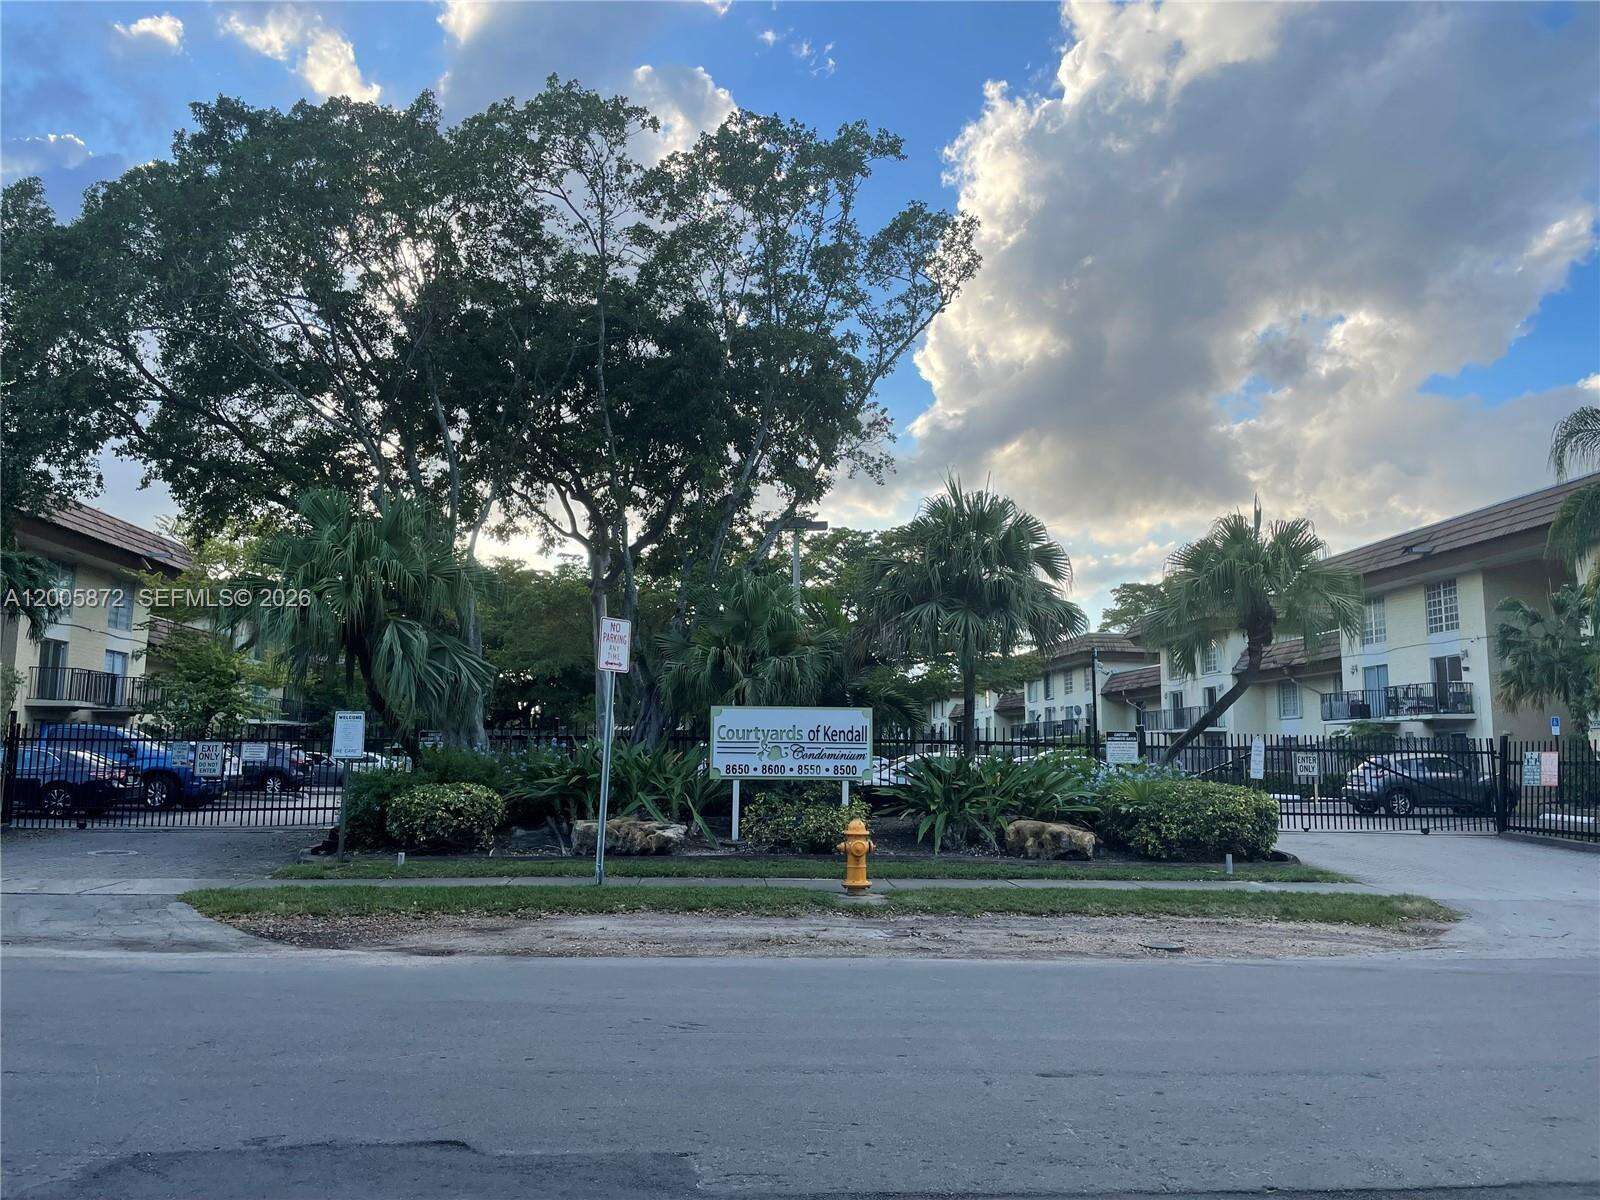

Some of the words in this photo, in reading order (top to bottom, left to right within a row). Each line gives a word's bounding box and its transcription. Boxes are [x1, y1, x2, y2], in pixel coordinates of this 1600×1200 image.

[610, 621, 621, 633] NO
[602, 632, 627, 645] PARKING
[717, 724, 804, 747] Courtyards
[807, 725, 820, 742] of
[823, 725, 868, 743] Kendall
[201, 744, 220, 752] EXIT
[790, 744, 867, 760] Condominium
[198, 752, 221, 760] ONLY
[1297, 755, 1317, 764] ENTER
[725, 764, 750, 775] 8650
[761, 764, 786, 775] 8600
[797, 764, 822, 775] 8550
[833, 765, 858, 776] 8500
[1299, 764, 1316, 773] ONLY
